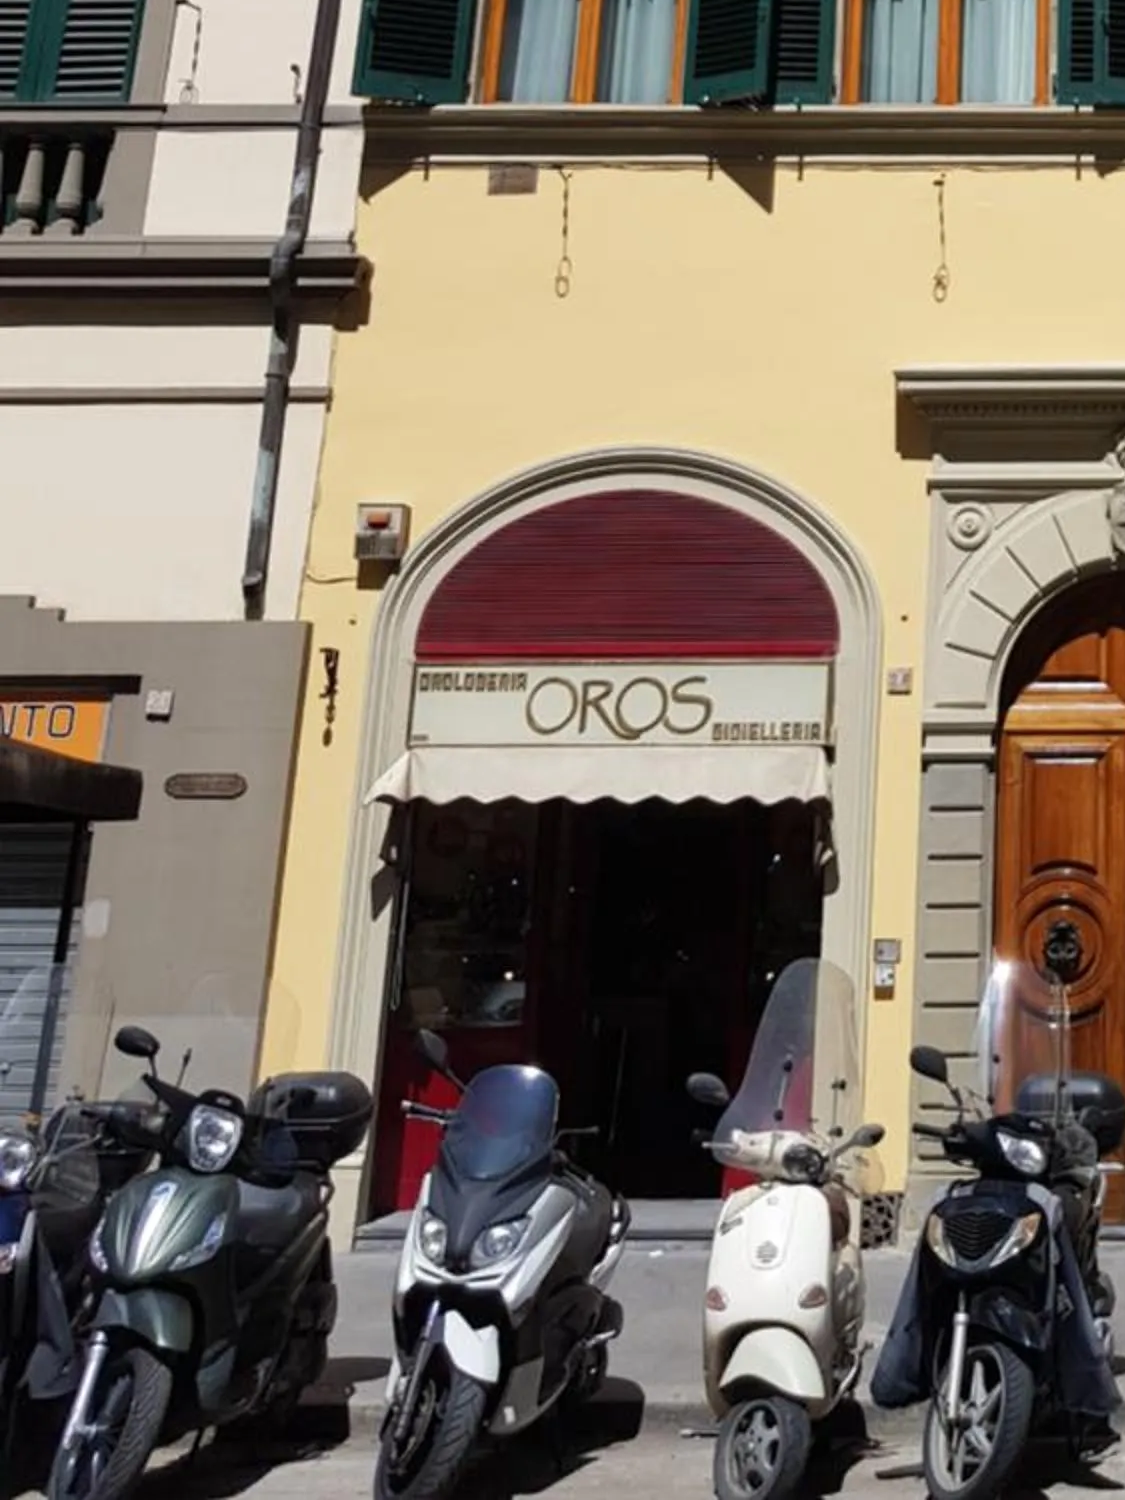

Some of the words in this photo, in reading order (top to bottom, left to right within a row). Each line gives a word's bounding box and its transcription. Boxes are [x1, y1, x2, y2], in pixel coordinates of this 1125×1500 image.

[419, 672, 528, 692] OROLOGERIA
[525, 675, 713, 741] OROS
[712, 721, 822, 741] GIOIELLERIA
